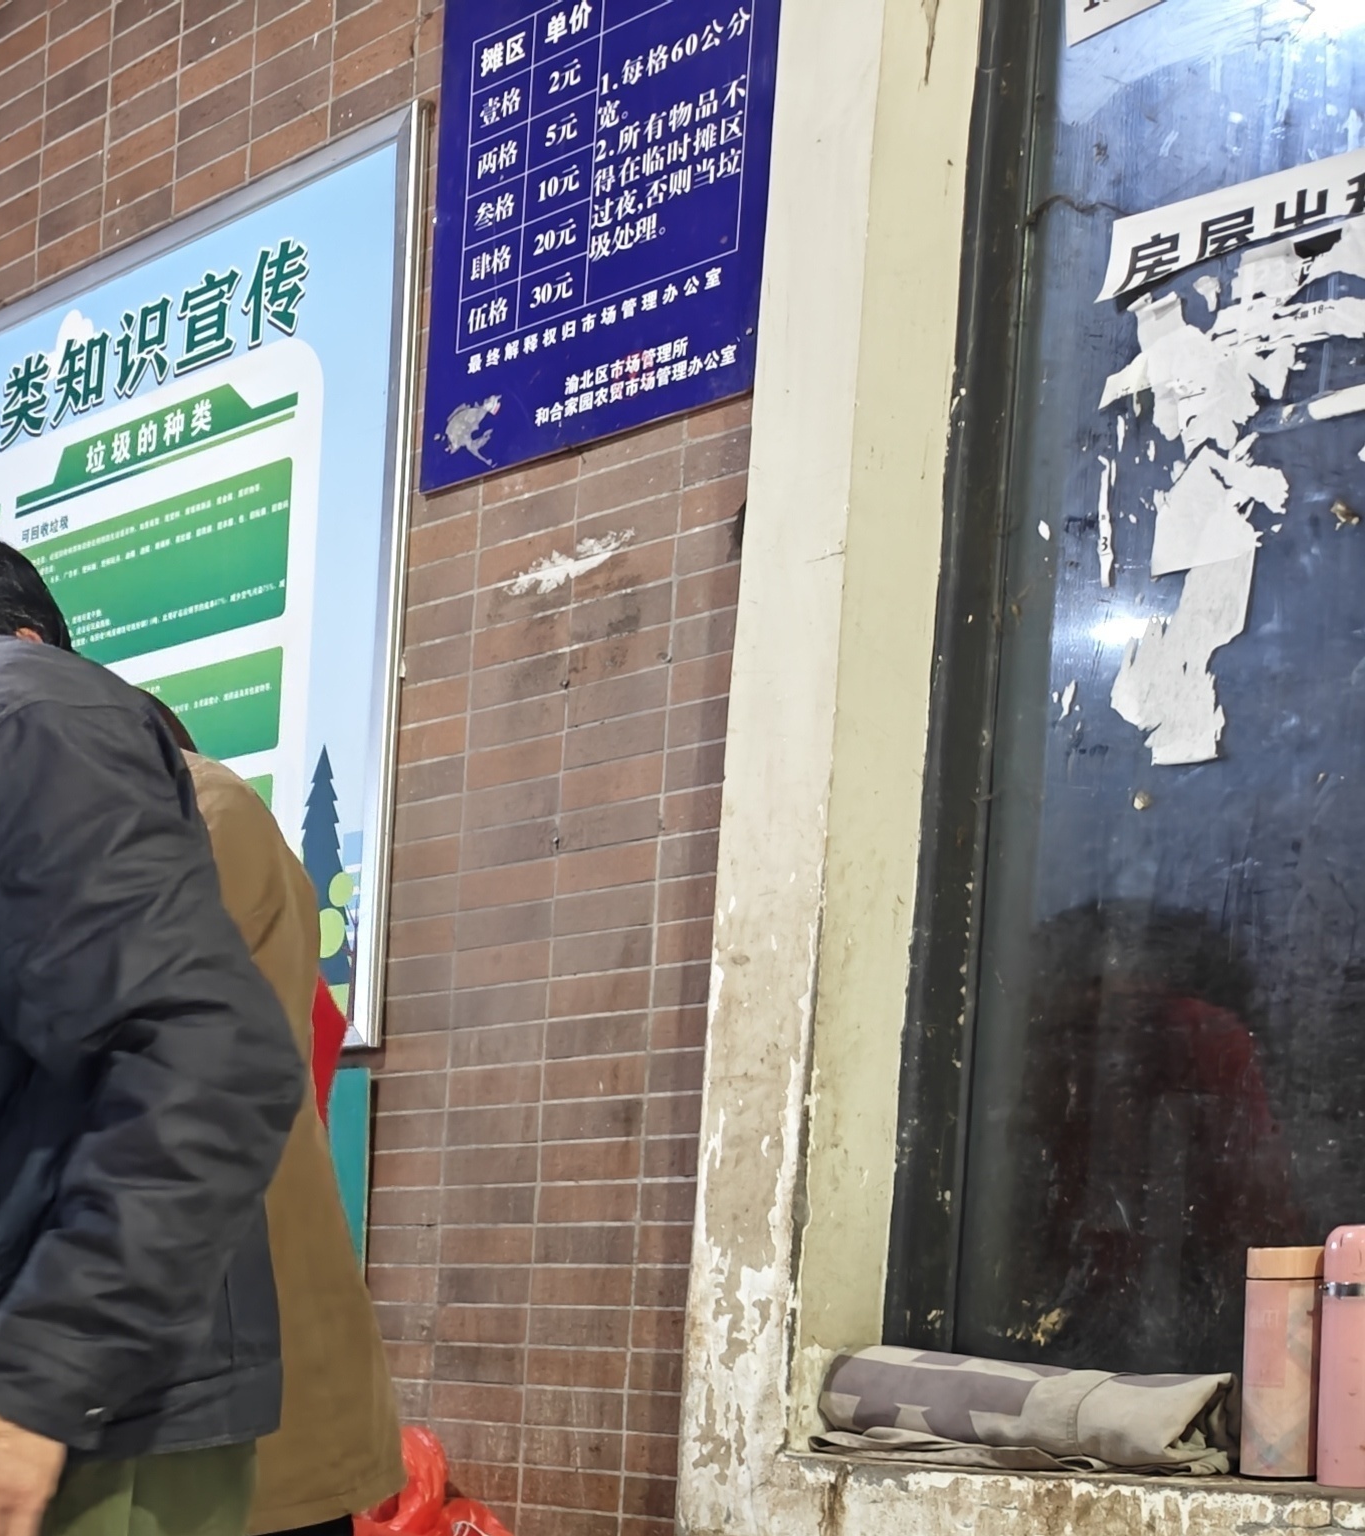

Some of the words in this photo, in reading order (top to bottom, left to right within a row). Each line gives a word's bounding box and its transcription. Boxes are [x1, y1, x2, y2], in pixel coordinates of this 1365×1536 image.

[479, 32, 526, 77] 摊区
[544, 0, 593, 45] 单价
[479, 88, 522, 129] 壹格
[548, 58, 582, 95] 2元
[476, 140, 519, 181] 两格
[544, 113, 579, 149] 5元
[592, 110, 745, 198] 得在临时摊区
[473, 192, 516, 231] 叁格
[538, 164, 581, 203] 10元
[469, 244, 512, 283] 肆格
[532, 218, 577, 258] 20元
[466, 266, 724, 375] 最终解释权归市场管理办公室
[467, 297, 509, 334] 伍格
[529, 272, 574, 310] 30元
[534, 343, 738, 427] 和合家园农贸市场管理办公室
[565, 336, 690, 396] 渝北区市场管理所
[84, 399, 213, 473] 垃圾的种类
[21, 515, 69, 544] 可回收垃圾
